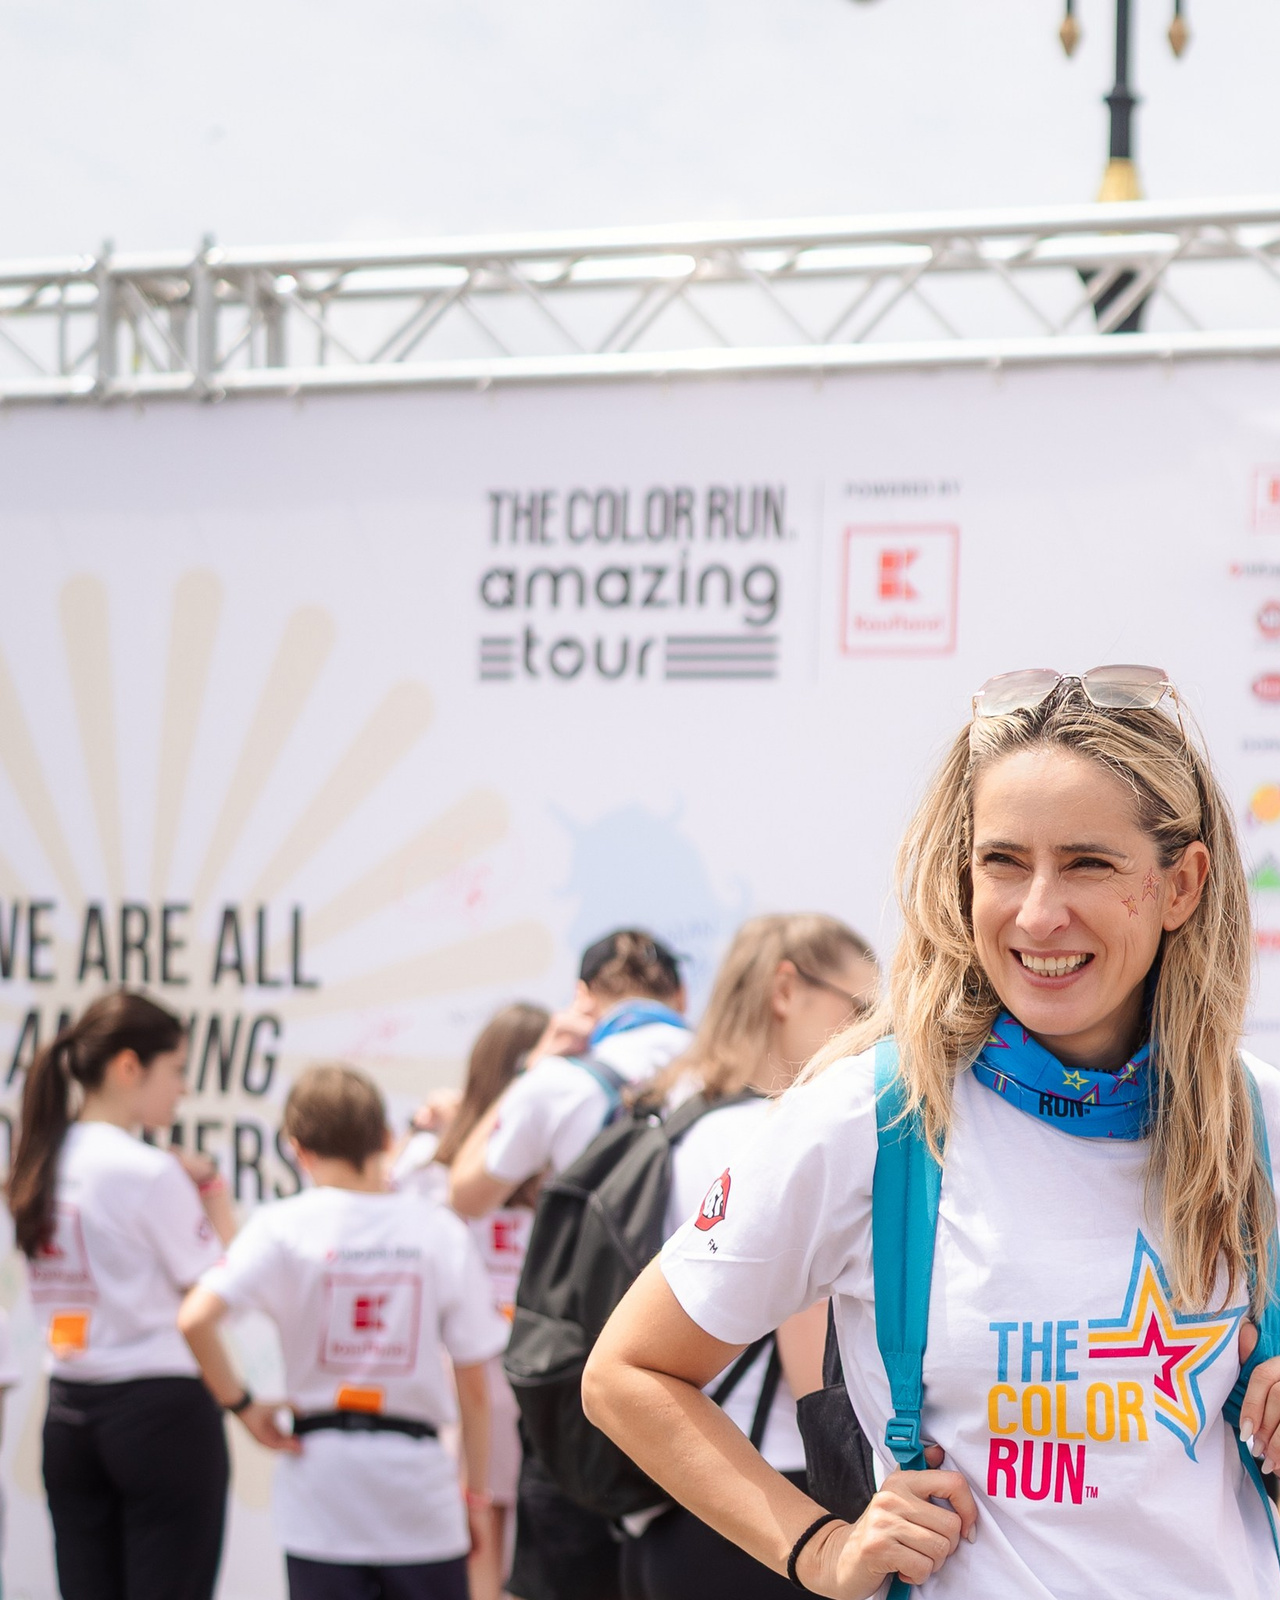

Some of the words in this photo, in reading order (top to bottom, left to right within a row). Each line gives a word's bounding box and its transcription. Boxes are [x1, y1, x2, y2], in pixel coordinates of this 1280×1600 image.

[489, 487, 555, 543] THE
[566, 485, 695, 542] COLOR
[703, 483, 787, 540] RUN
[480, 546, 782, 627] amazing
[520, 624, 656, 680] tour
[78, 901, 191, 984] ARE
[212, 903, 320, 989] ALL
[1038, 1092, 1084, 1118] RUN
[989, 1320, 1079, 1382] THE
[987, 1381, 1149, 1443] COLOR
[986, 1438, 1086, 1505] RUN
